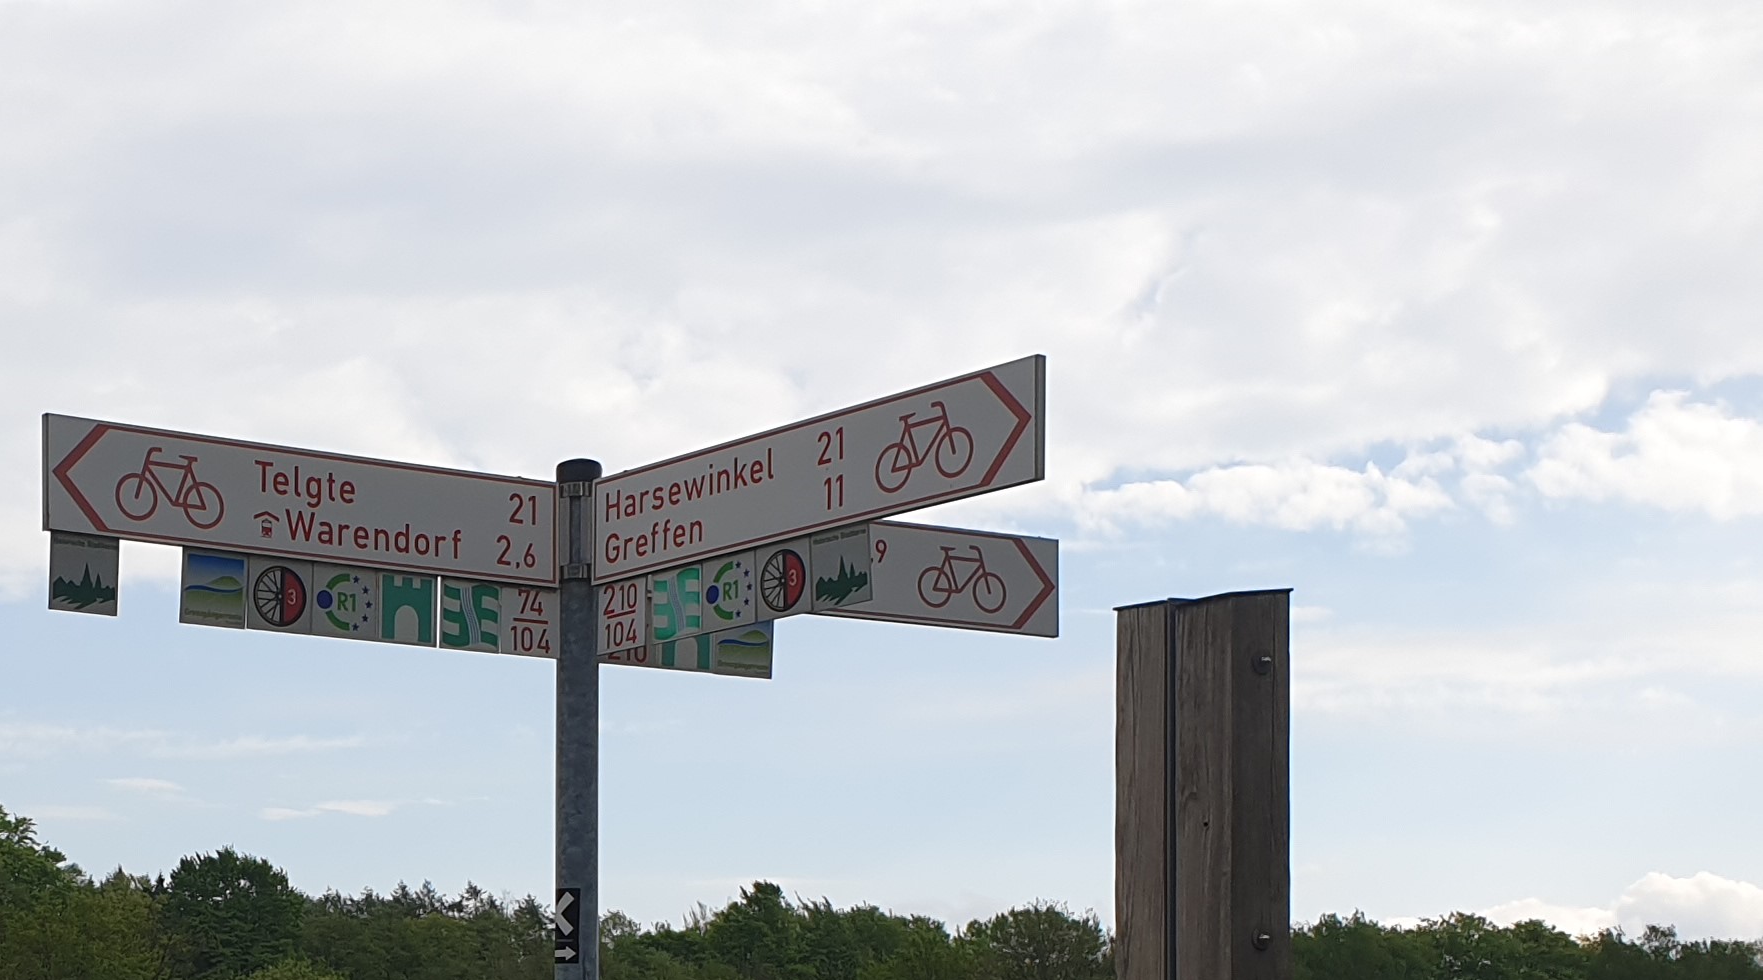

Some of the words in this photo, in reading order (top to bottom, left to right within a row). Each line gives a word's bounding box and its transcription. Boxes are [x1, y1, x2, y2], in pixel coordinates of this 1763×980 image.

[605, 448, 775, 523] Harsewinkel
[817, 426, 845, 466] 21
[254, 459, 356, 508] Telgte
[509, 492, 538, 526] 21
[605, 519, 704, 564] Greffen
[823, 474, 845, 511] 11
[285, 508, 462, 559] Warendorf
[495, 534, 537, 570] 2,6
[722, 580, 739, 601] R1
[788, 569, 798, 587] 3
[287, 589, 297, 606] 3
[338, 592, 357, 613] R1
[517, 589, 544, 617] 74
[603, 583, 638, 616] 210
[510, 626, 551, 654] 104
[604, 618, 638, 650] 104
